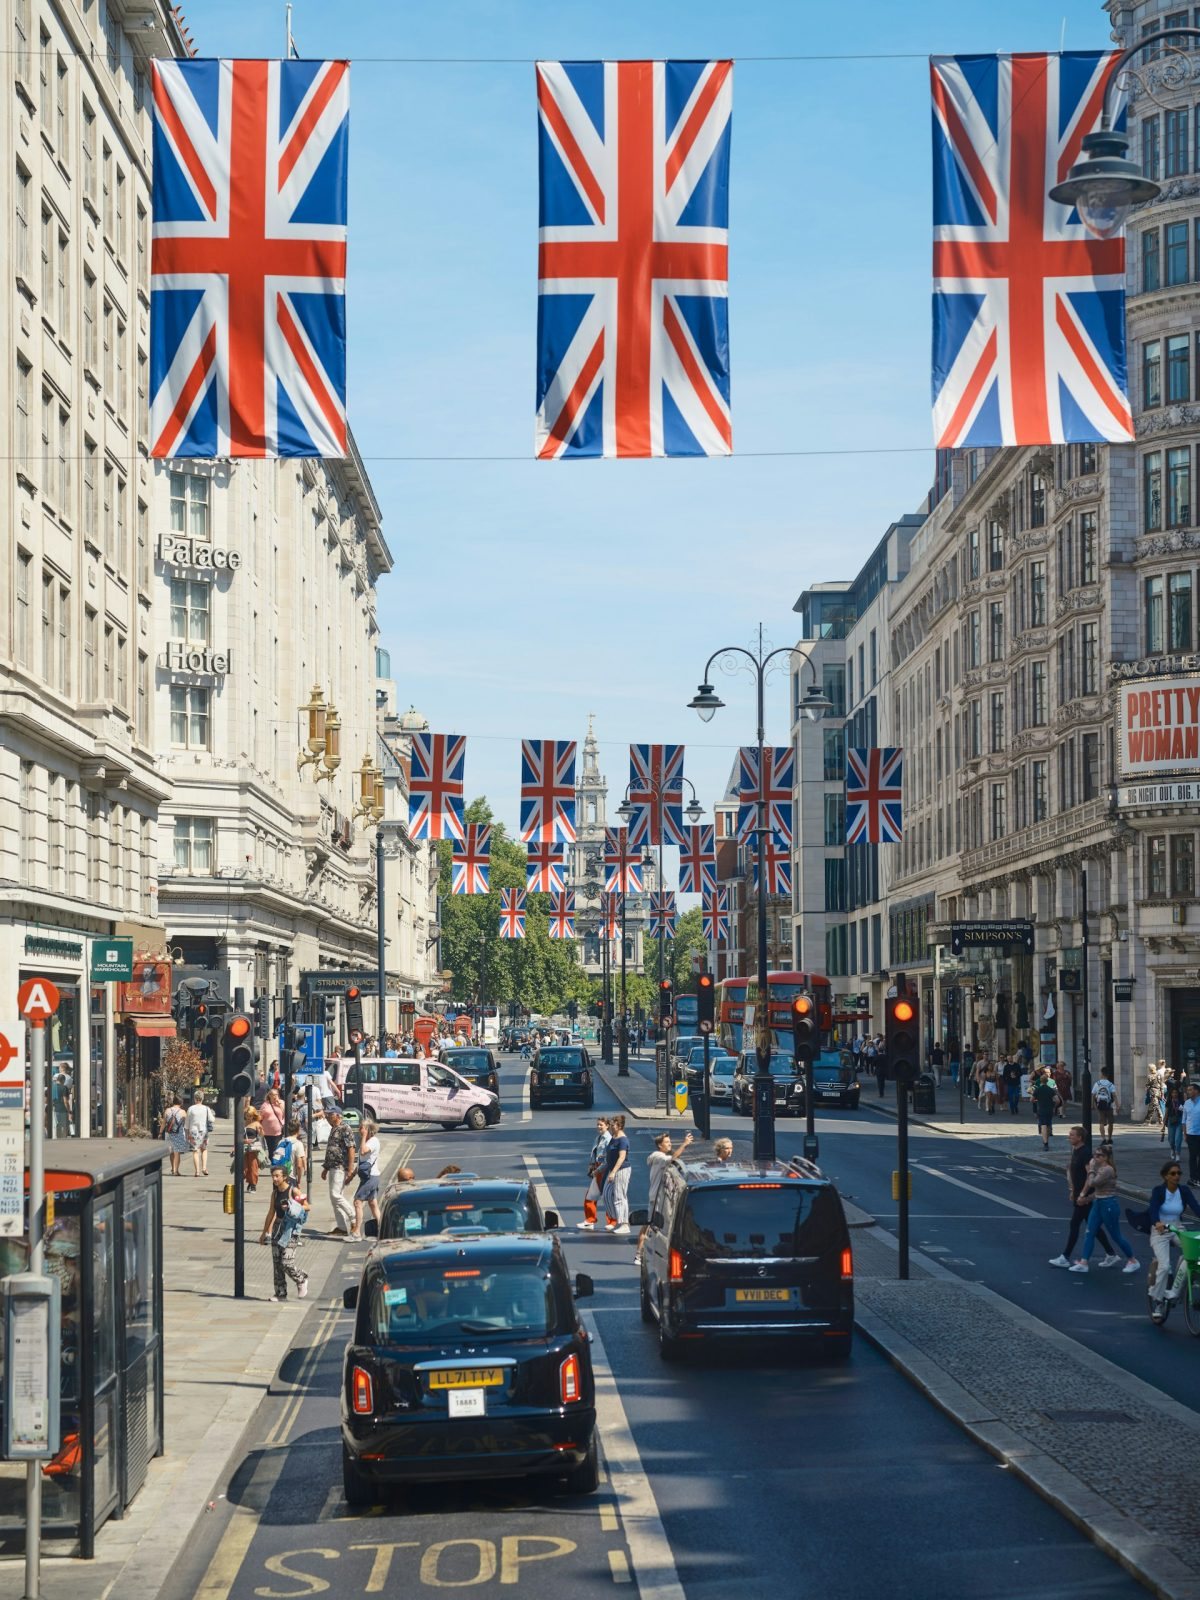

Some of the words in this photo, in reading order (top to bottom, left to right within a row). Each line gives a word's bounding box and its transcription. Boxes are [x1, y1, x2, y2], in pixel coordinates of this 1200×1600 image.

[158, 533, 242, 570] Palace
[166, 641, 234, 675] Hotel
[1111, 659, 1158, 679] SAVOY
[1127, 686, 1200, 730] PRETTY
[1128, 726, 1198, 764] WOMAN
[1138, 786, 1157, 803] NIGHT
[1159, 785, 1175, 801] OUT.
[1177, 784, 1194, 800] BIG.
[964, 931, 1022, 941] SIMPSON'S
[23, 983, 52, 1013] A
[470, 1369, 496, 1383] TTY
[253, 1535, 578, 1598] STOP
